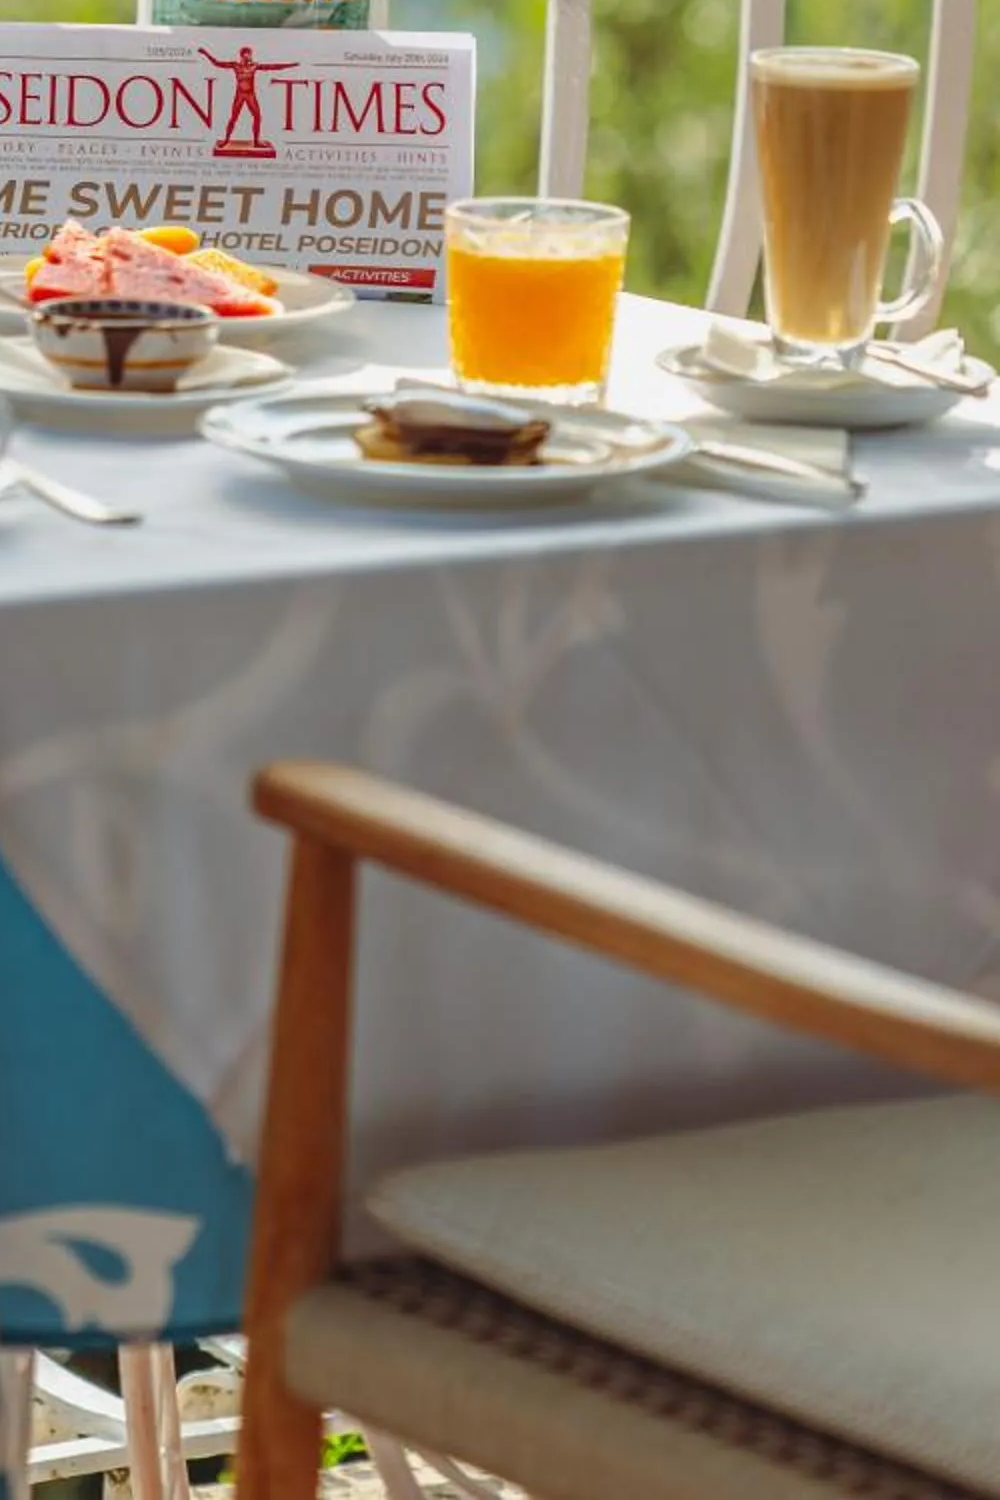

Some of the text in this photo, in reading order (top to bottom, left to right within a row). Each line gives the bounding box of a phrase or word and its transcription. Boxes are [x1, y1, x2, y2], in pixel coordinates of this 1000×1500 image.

[270, 78, 447, 136] TIMES
[58, 143, 118, 156] PLACES
[284, 148, 378, 163] ACTIVITIES
[397, 151, 448, 165] HINTS
[67, 181, 265, 224] SWEET
[280, 187, 447, 231] HOME
[199, 231, 290, 252] HOTEL
[297, 235, 443, 258] POSEIDON
[332, 269, 411, 283] ACTIVITIES
